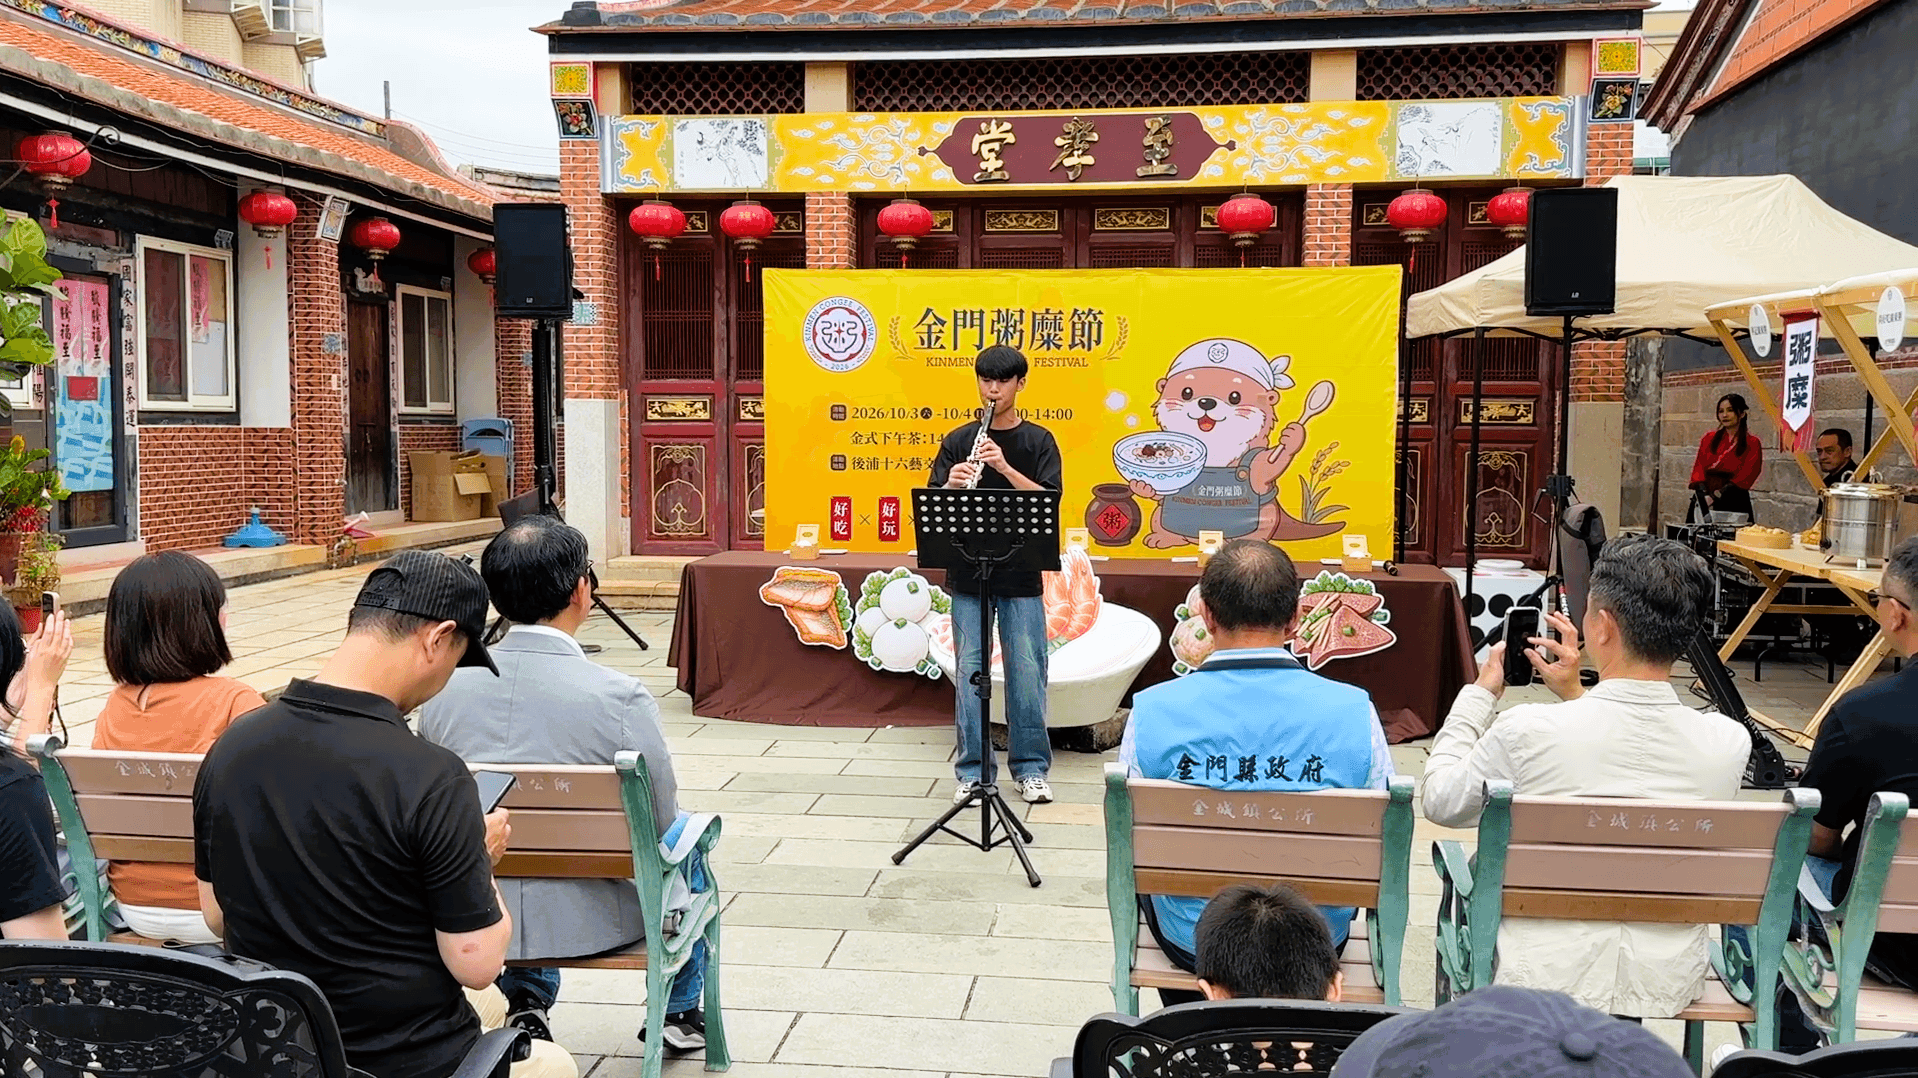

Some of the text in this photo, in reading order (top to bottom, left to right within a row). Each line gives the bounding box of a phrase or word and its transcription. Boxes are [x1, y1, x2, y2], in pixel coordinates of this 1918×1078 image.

[804, 298, 874, 342] KINMEN CONGEE FESTIVAL
[913, 306, 1104, 353] 金門粥糜節
[925, 356, 1088, 368] KINMEN FESTIVAL
[1786, 330, 1813, 410] 粥糜
[833, 501, 849, 535] 好吃
[881, 501, 897, 536] 好玩
[1102, 511, 1121, 530] 粥
[1176, 752, 1325, 783] 金門縣政府
